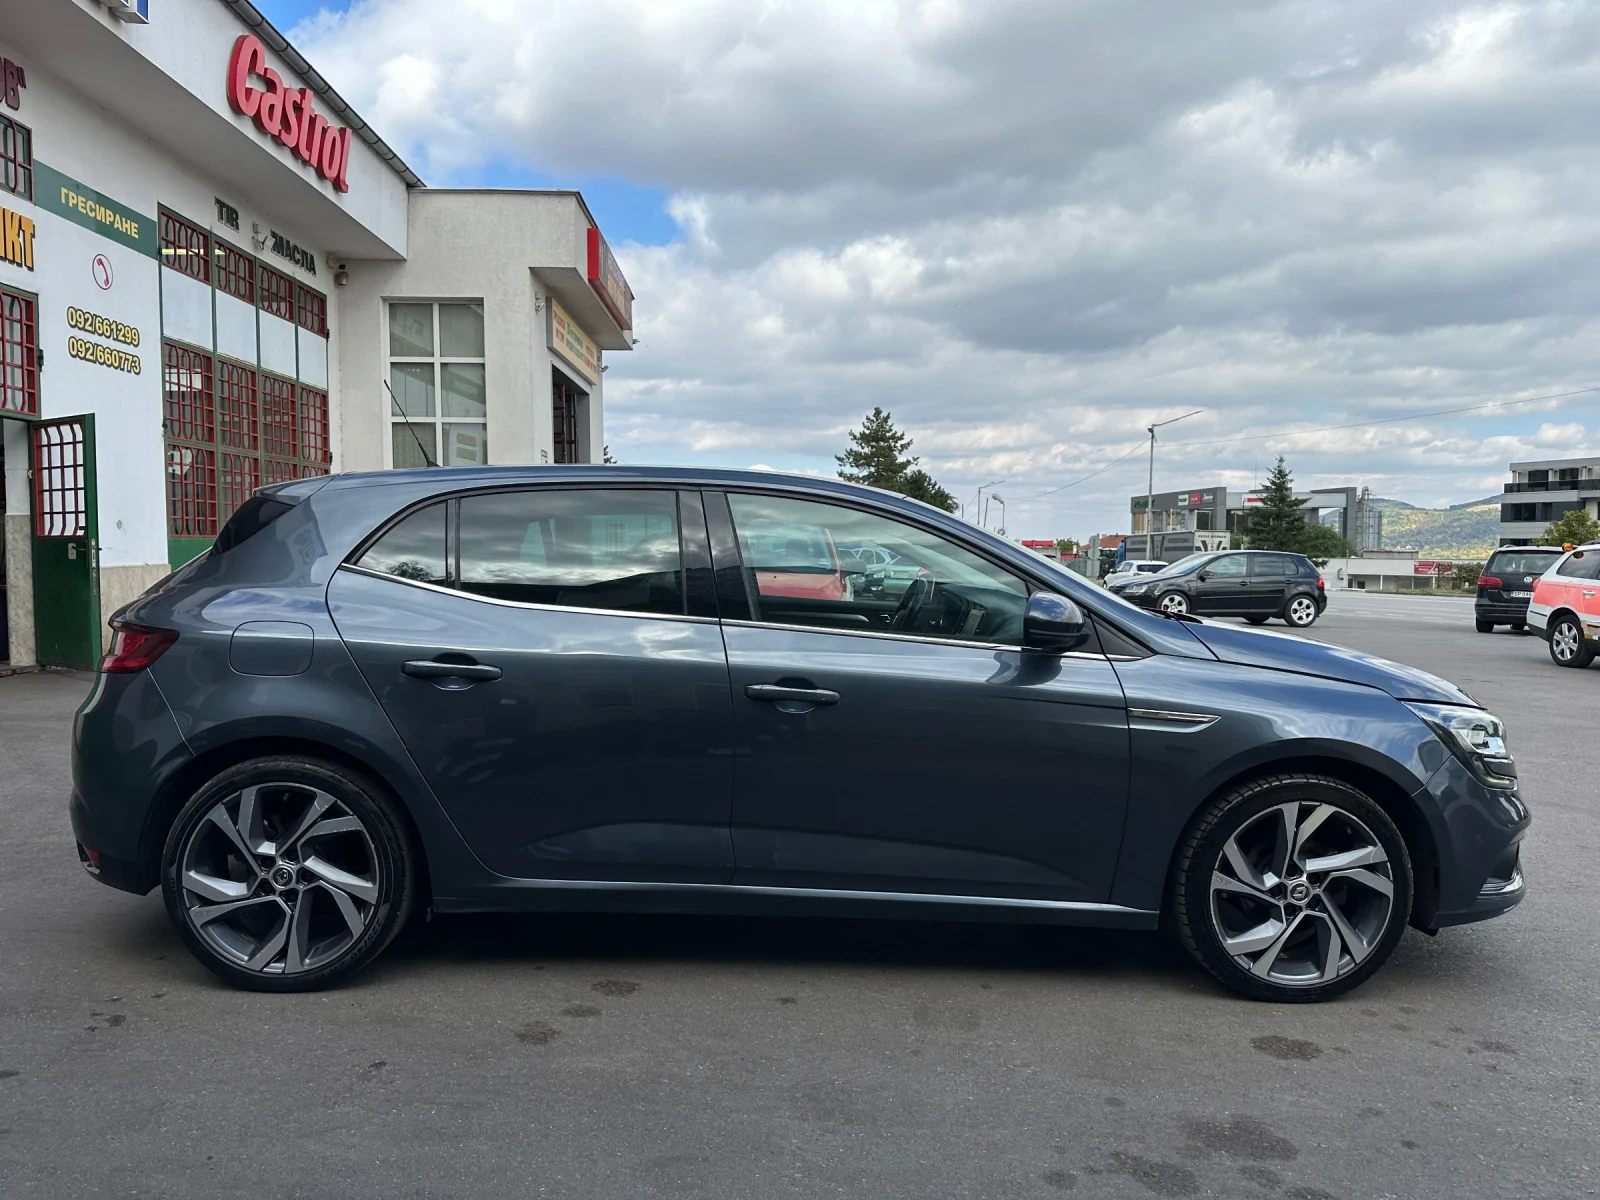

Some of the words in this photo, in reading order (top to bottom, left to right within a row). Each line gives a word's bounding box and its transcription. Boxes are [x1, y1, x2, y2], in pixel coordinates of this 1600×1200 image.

[228, 34, 352, 193] Castrol
[61, 186, 139, 239] ГРЕСИРАНЕ
[214, 196, 240, 233] TIR
[67, 306, 140, 347] 092/661299
[68, 336, 141, 375] 092/660773
